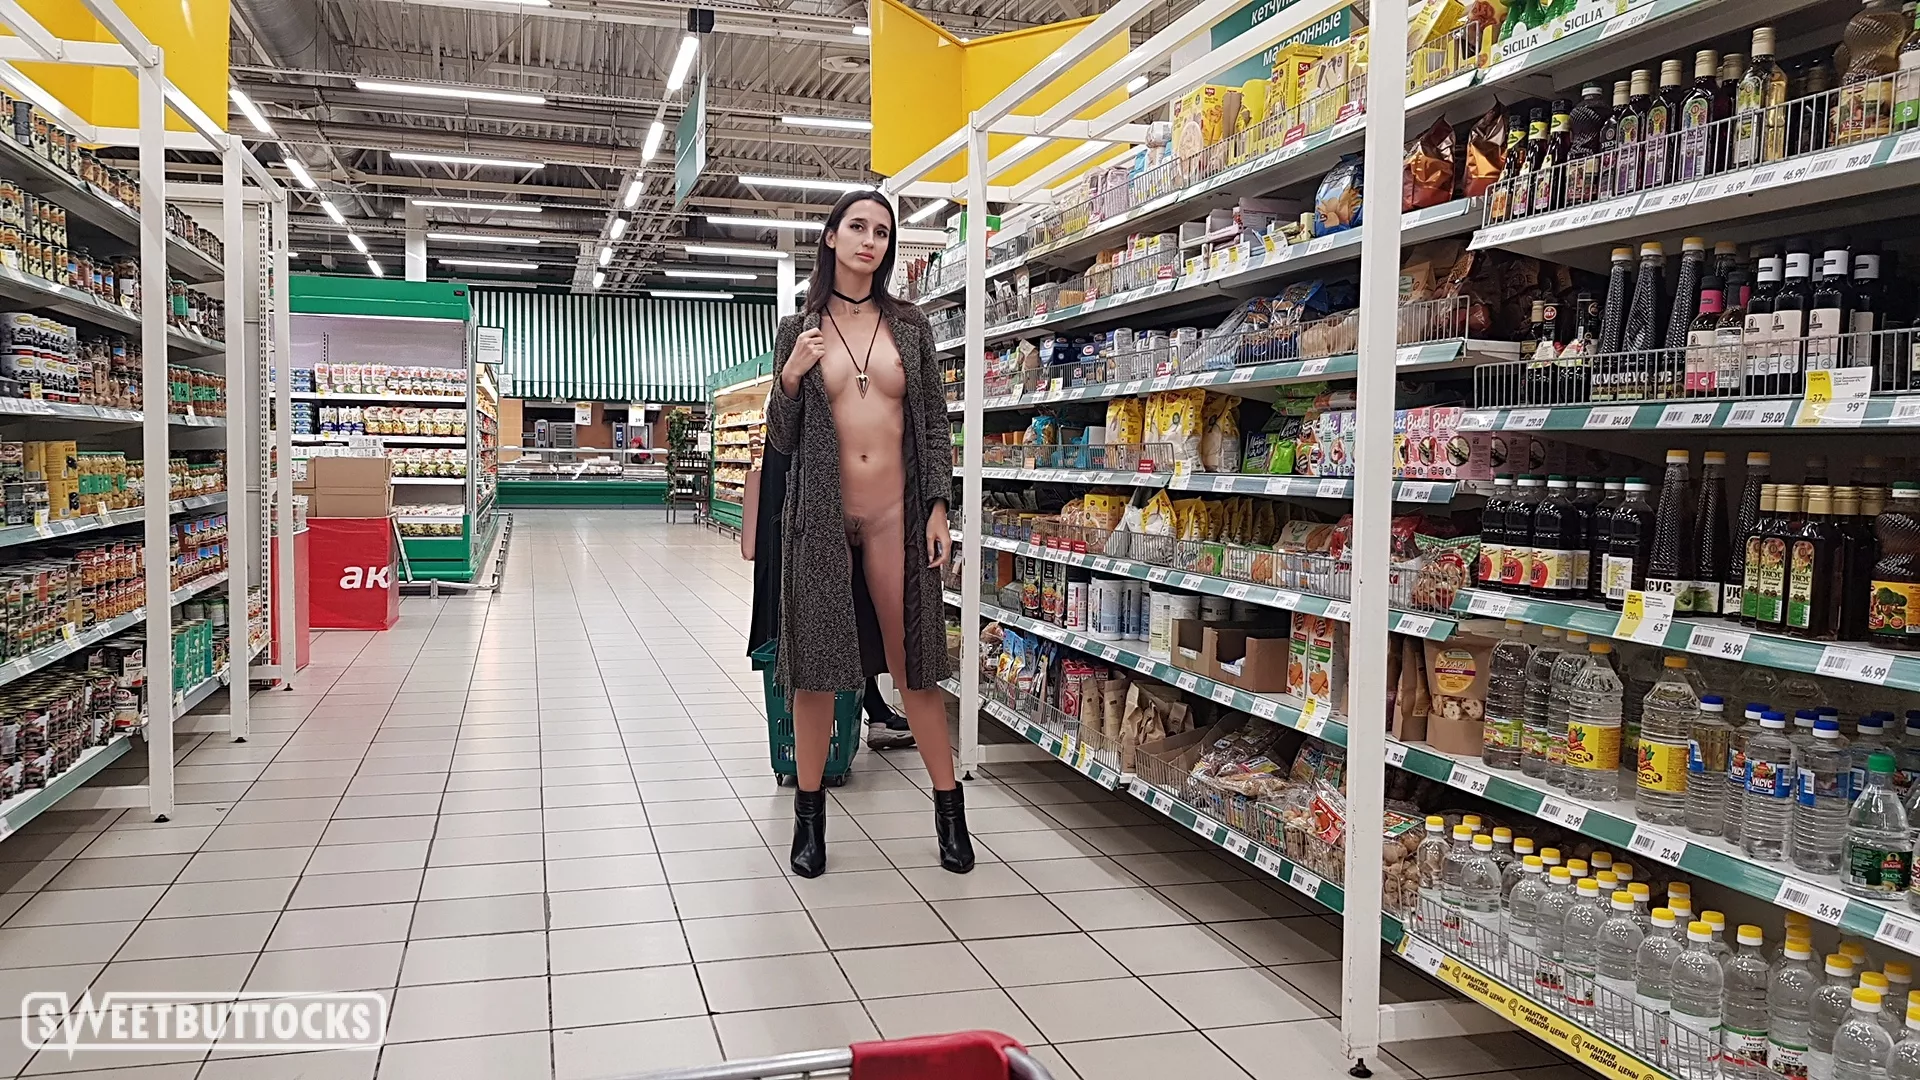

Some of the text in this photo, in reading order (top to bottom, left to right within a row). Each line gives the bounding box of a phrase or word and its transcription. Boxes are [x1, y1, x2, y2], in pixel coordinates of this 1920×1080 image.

[1564, 8, 1602, 32] SICILIA
[1502, 35, 1537, 56] SICILIA
[1845, 154, 1871, 168] 119.00
[1783, 168, 1806, 181] 46.99
[1724, 181, 1746, 194] 56.99
[1321, 416, 1338, 434] Bite
[1395, 416, 1407, 430] ite
[1407, 413, 1428, 432] Bite
[1691, 413, 1712, 424] 119.00
[1761, 412, 1785, 424] 159.00
[339, 566, 390, 589] ак
[1721, 643, 1743, 655] 56.99
[1861, 665, 1887, 680] 46.99
[1752, 778, 1773, 788] УКСУС
[1564, 814, 1582, 827] 32.99
[1660, 848, 1680, 863] 23.40
[1817, 903, 1842, 920] 36.99
[1461, 971, 1489, 989] ГАРАНТИЯ
[1467, 981, 1506, 1004] НИЗКОЙ ЦЕНЫ
[1518, 1005, 1549, 1024] ГАРАНТИЯ
[1525, 1014, 1569, 1040] НИЗКОЙ ЦЕНЫ
[1582, 1041, 1616, 1062] ГАРАНТИЯ
[1781, 1054, 1799, 1062] УКСУС
[1589, 1053, 1640, 1080] НИЗКОЙ ЦЕНЫ
